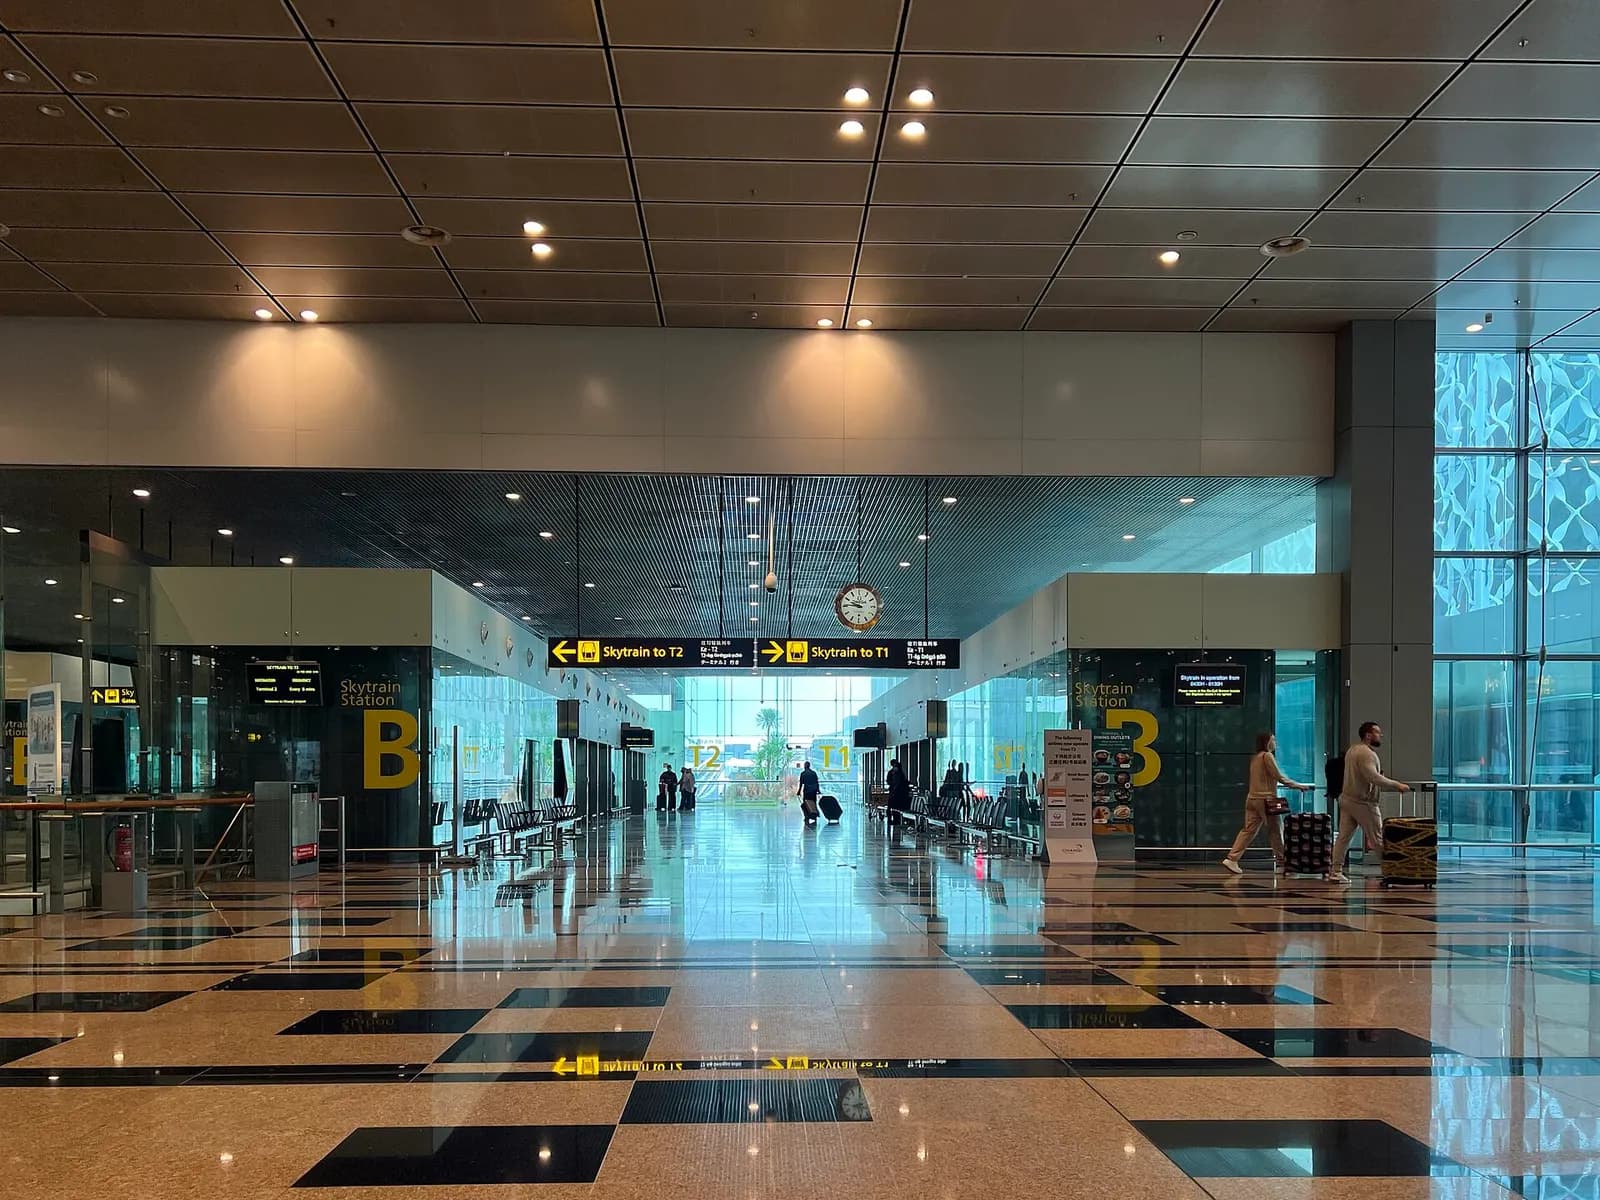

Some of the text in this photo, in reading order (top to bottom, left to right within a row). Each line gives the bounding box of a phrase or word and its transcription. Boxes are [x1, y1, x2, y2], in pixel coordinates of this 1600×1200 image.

[603, 646, 684, 660] Skytrain to T2
[811, 646, 889, 660] Skytrain to T1
[340, 679, 401, 695] Skytrain
[1075, 681, 1134, 696] Skytrain
[341, 694, 395, 706] Station
[1075, 695, 1127, 707] Station
[364, 709, 421, 789] B
[688, 745, 720, 768] T2
[818, 745, 848, 768] T1
